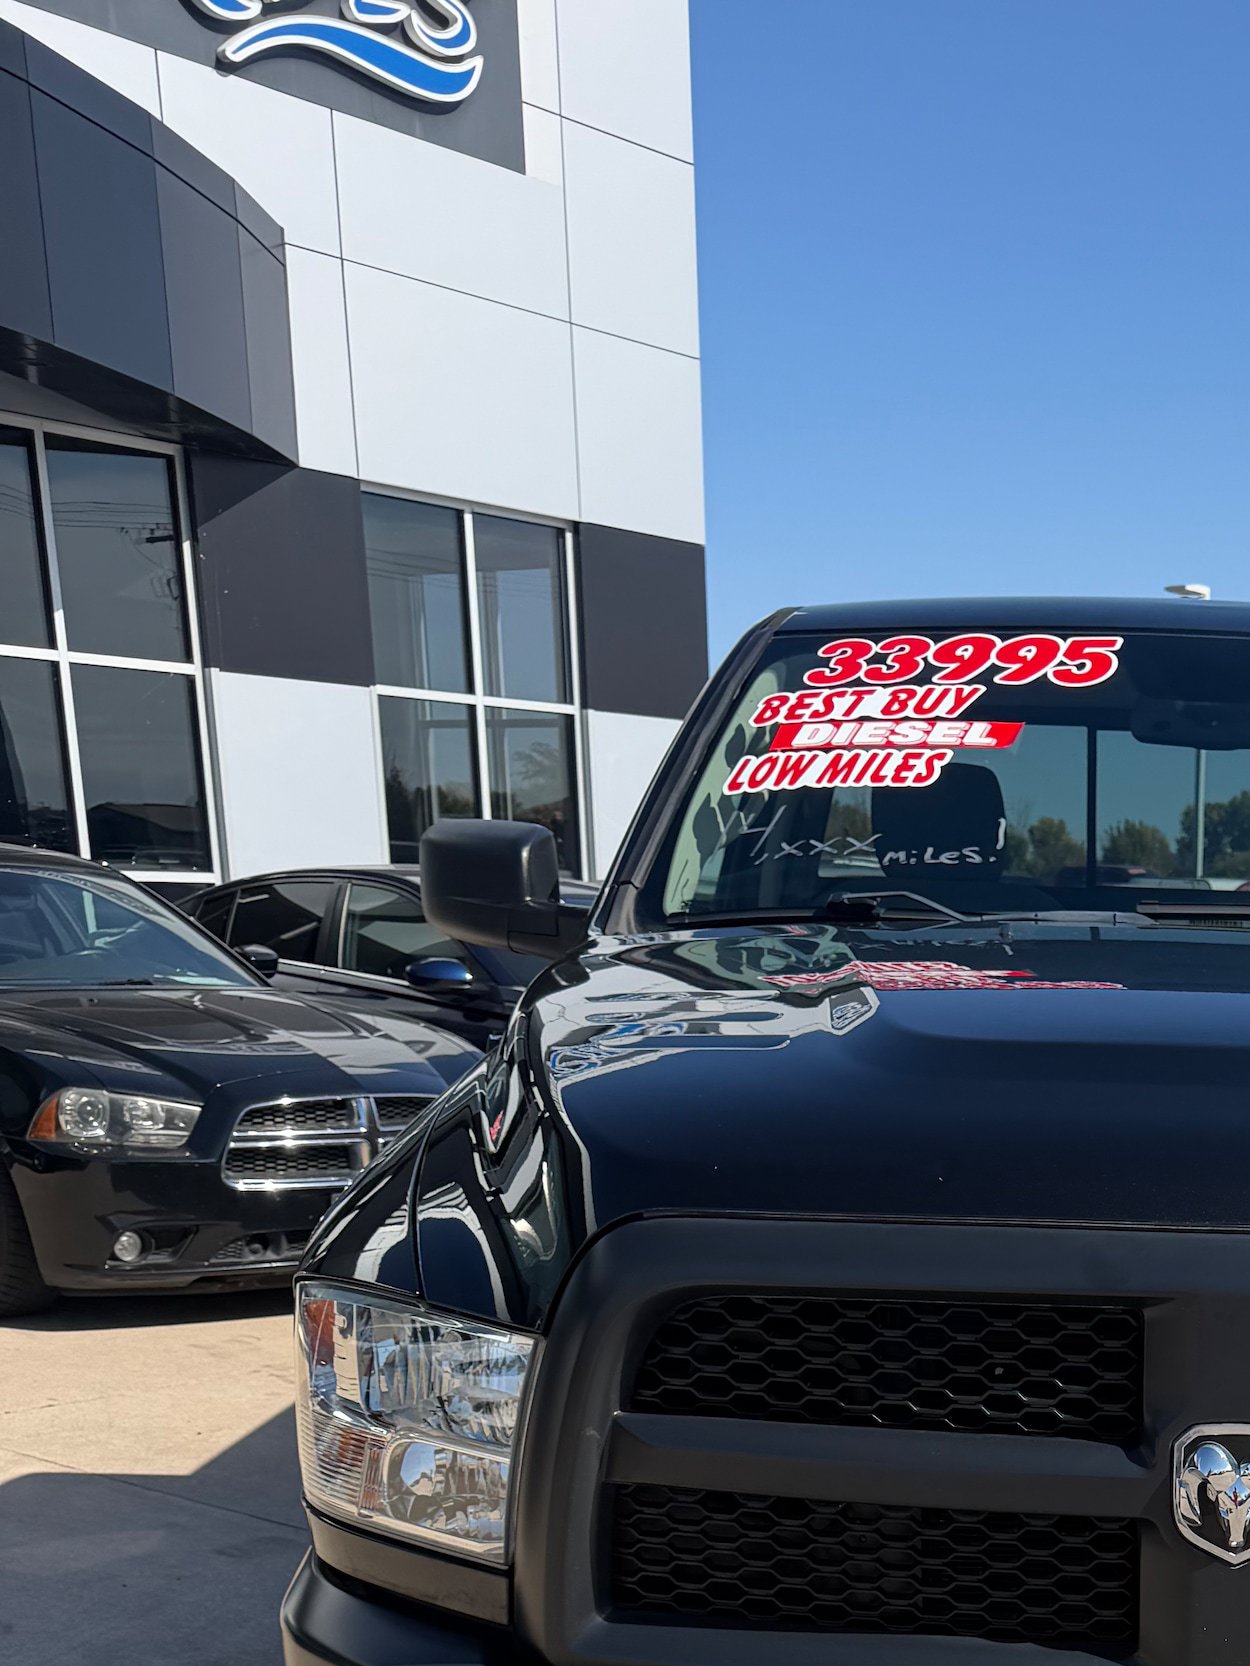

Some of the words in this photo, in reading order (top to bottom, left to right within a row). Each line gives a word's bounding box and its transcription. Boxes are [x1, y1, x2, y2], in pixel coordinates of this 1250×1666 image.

[803, 634, 1124, 687] 33995
[750, 689, 878, 726] BEST
[882, 685, 987, 719] BUY
[792, 721, 998, 747] DIESEL
[723, 753, 819, 795] LOW
[815, 749, 953, 789] MILES
